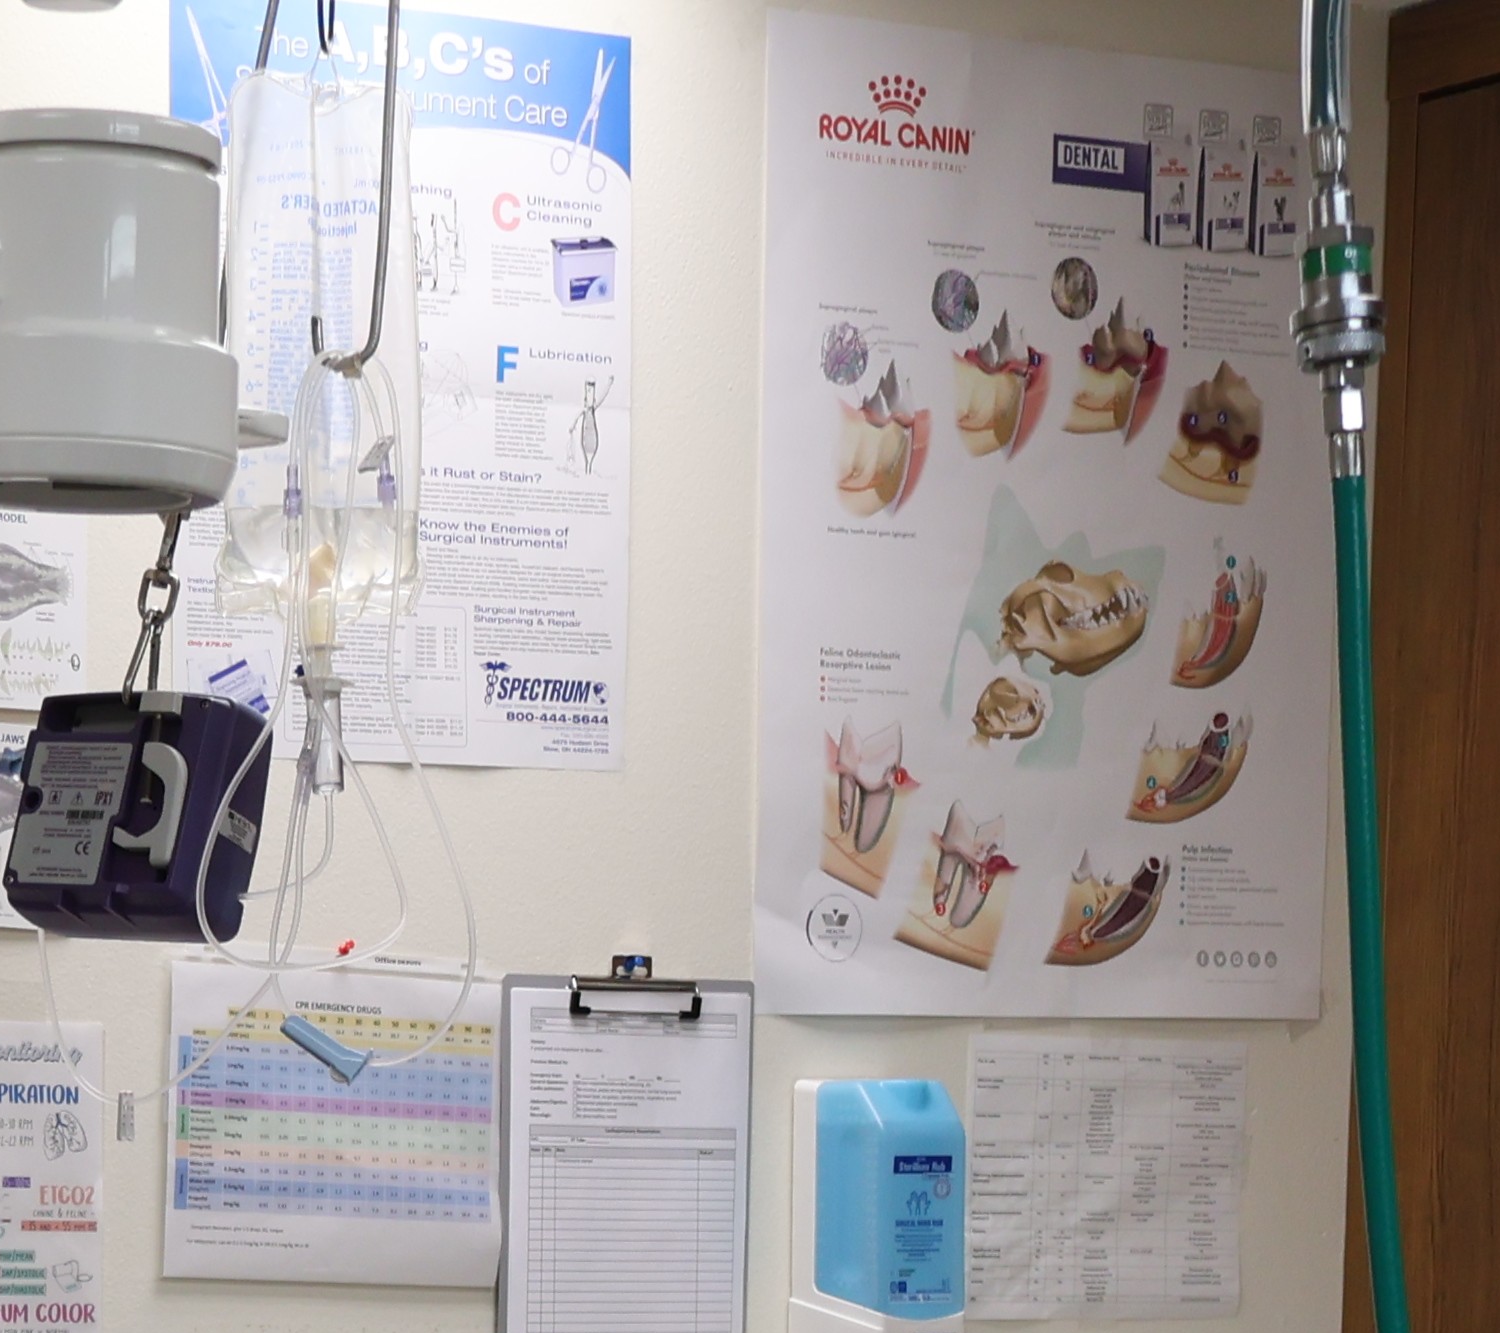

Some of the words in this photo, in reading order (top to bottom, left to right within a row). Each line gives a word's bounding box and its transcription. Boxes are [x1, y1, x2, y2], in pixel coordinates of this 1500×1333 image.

[525, 59, 551, 86] of
[505, 96, 567, 127] Care
[819, 114, 891, 146] ROYAL
[898, 122, 970, 155] CANIN
[826, 150, 882, 164] INCREDIBLE
[887, 157, 896, 165] IN
[900, 159, 928, 169] EVERY
[1063, 144, 1118, 170] DENTAL
[493, 193, 521, 231] C
[526, 195, 601, 213] Ultrasonic
[526, 210, 592, 228] Cleaning
[497, 345, 519, 383] F
[529, 348, 613, 365] Lubrication
[430, 467, 438, 478] it
[443, 467, 475, 480] Rust
[481, 471, 494, 480] or
[500, 471, 542, 484] Stain?
[420, 518, 460, 532] Know
[464, 520, 486, 533] the
[491, 522, 551, 536] Enemies
[555, 526, 569, 537] of
[420, 532, 476, 545] Surgical
[480, 535, 568, 550] Instruments!
[474, 605, 516, 616] Surgical
[519, 607, 575, 617] Instrument
[474, 615, 533, 627] Sharpening
[538, 618, 545, 626] &
[548, 619, 581, 627] Repair
[819, 645, 845, 660] Feline
[846, 648, 901, 662] Odontoclastic
[819, 659, 864, 672] Resorptive
[866, 662, 892, 673] Lesion
[498, 676, 592, 703] SPECTRUM
[507, 712, 609, 724] 800-444-5644
[1, 733, 25, 744] JAWS
[1182, 844, 1199, 857] Pulp
[1201, 845, 1233, 855] Infection
[296, 1001, 310, 1011] CPR
[311, 1002, 355, 1013] EMERGENCY
[357, 1004, 382, 1014] DRUGS
[392, 1020, 399, 1028] 50
[481, 1027, 491, 1035] 100
[19, 1118, 33, 1130] RPM
[20, 1135, 34, 1147] RPM
[39, 1184, 94, 1206] ETCO2
[35, 1303, 95, 1324] COLOR
